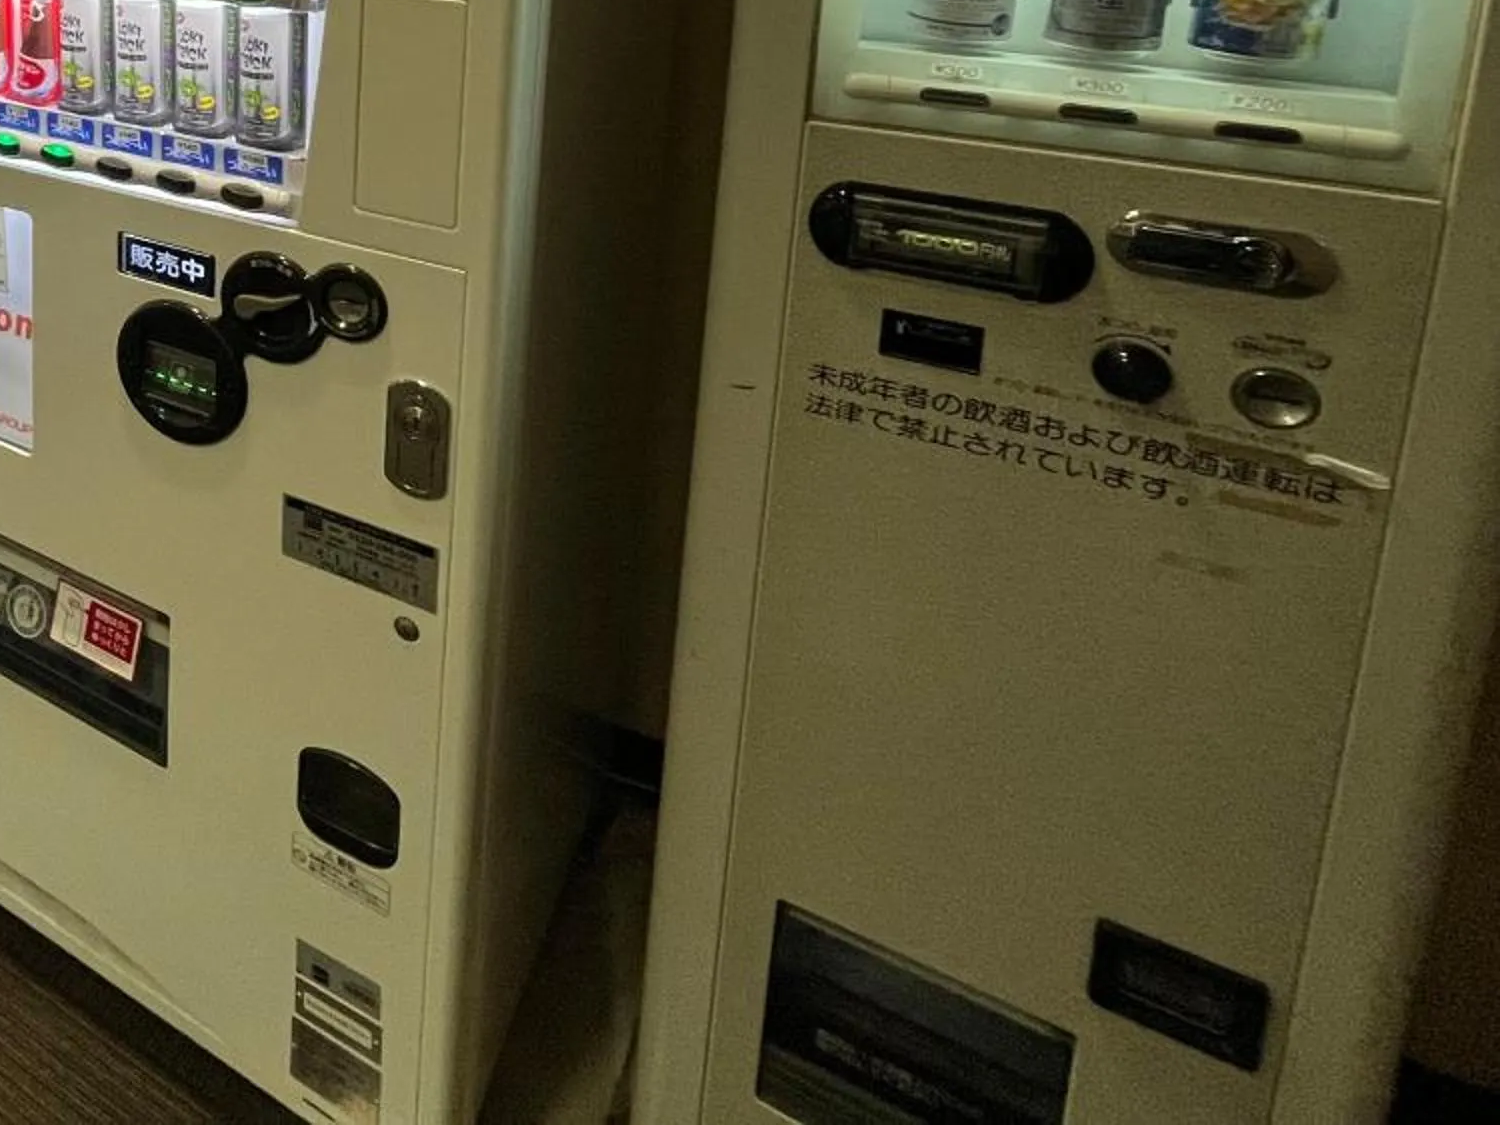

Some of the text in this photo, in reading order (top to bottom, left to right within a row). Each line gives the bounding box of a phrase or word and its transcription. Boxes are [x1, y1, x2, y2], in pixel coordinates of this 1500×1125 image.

[129, 242, 206, 283] 販売中
[804, 392, 1191, 508] 法律で禁止されています。
[808, 362, 1345, 507] 未成年者の飲酒および飲酒運転は
